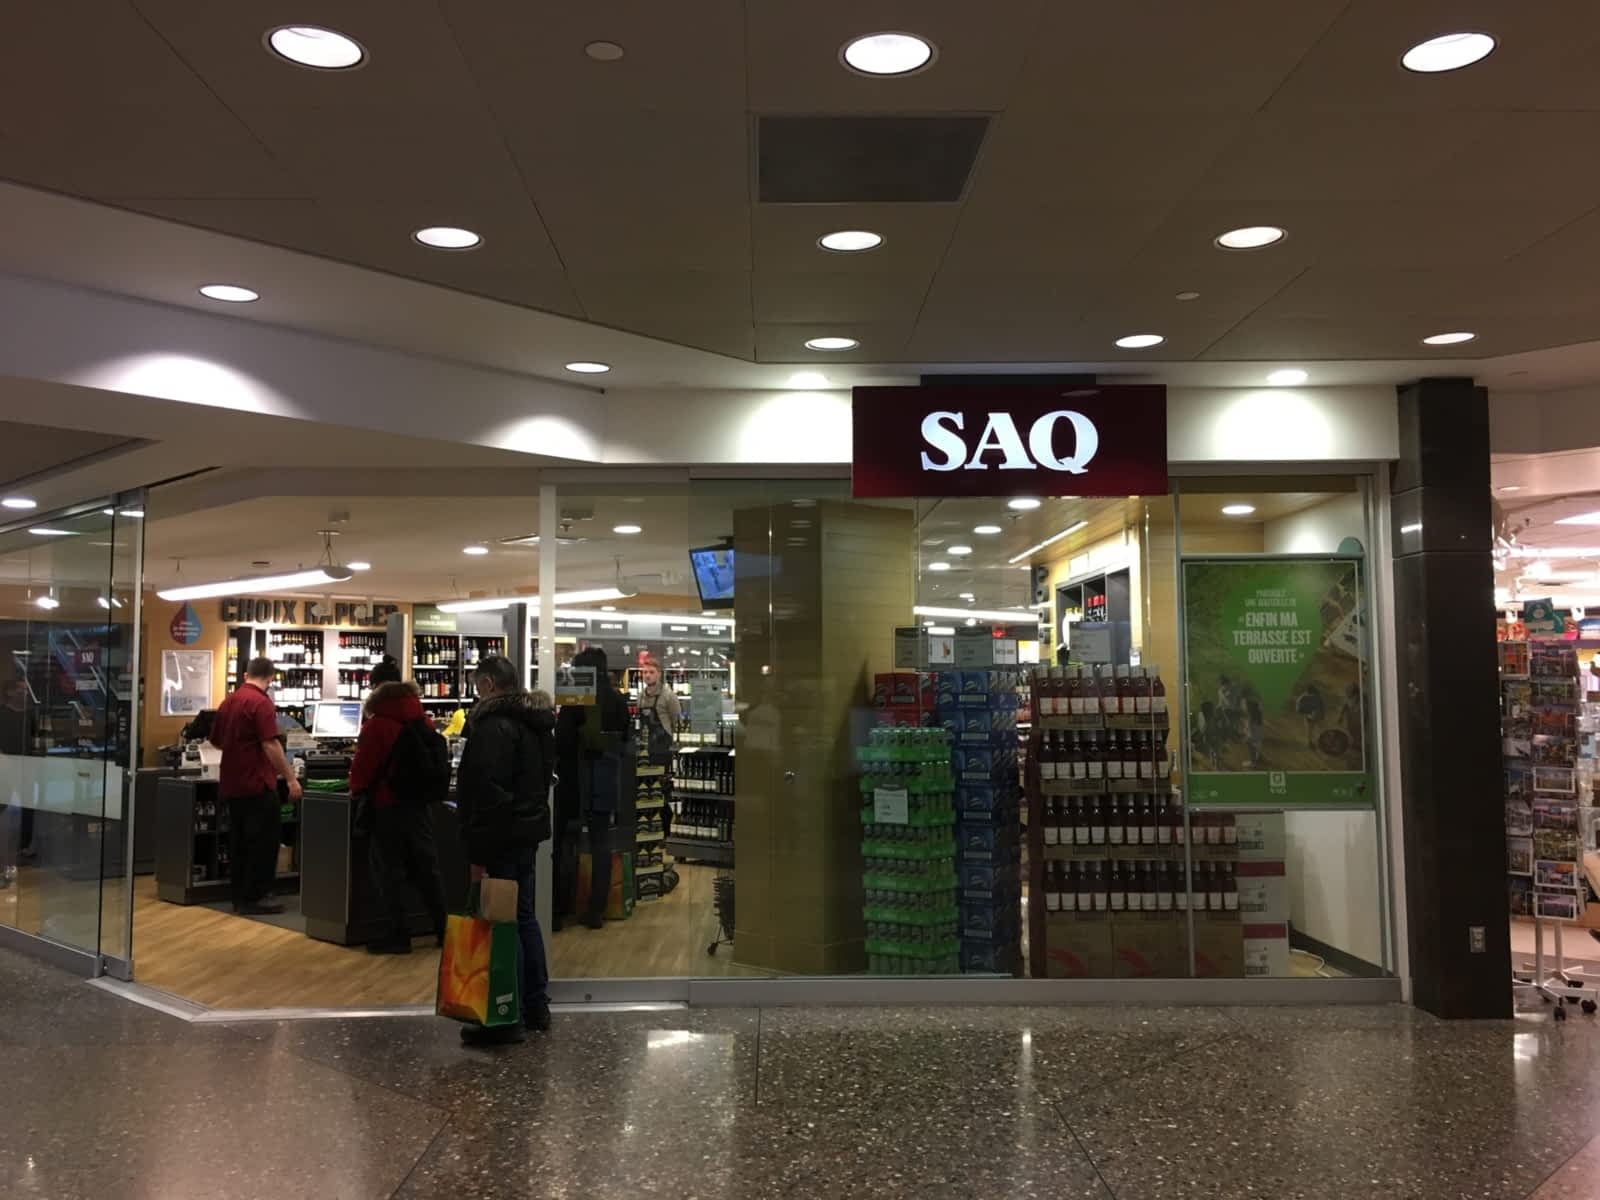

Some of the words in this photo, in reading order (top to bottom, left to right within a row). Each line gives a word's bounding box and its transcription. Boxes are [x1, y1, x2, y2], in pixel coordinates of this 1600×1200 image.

[920, 409, 1099, 474] SAQ
[223, 598, 297, 624] CHOIX
[304, 601, 399, 626] RPIE
[1280, 611, 1298, 627] MA
[1232, 630, 1289, 646] TERRASSE
[1291, 630, 1312, 645] EST
[1248, 648, 1297, 664] OUVERTE
